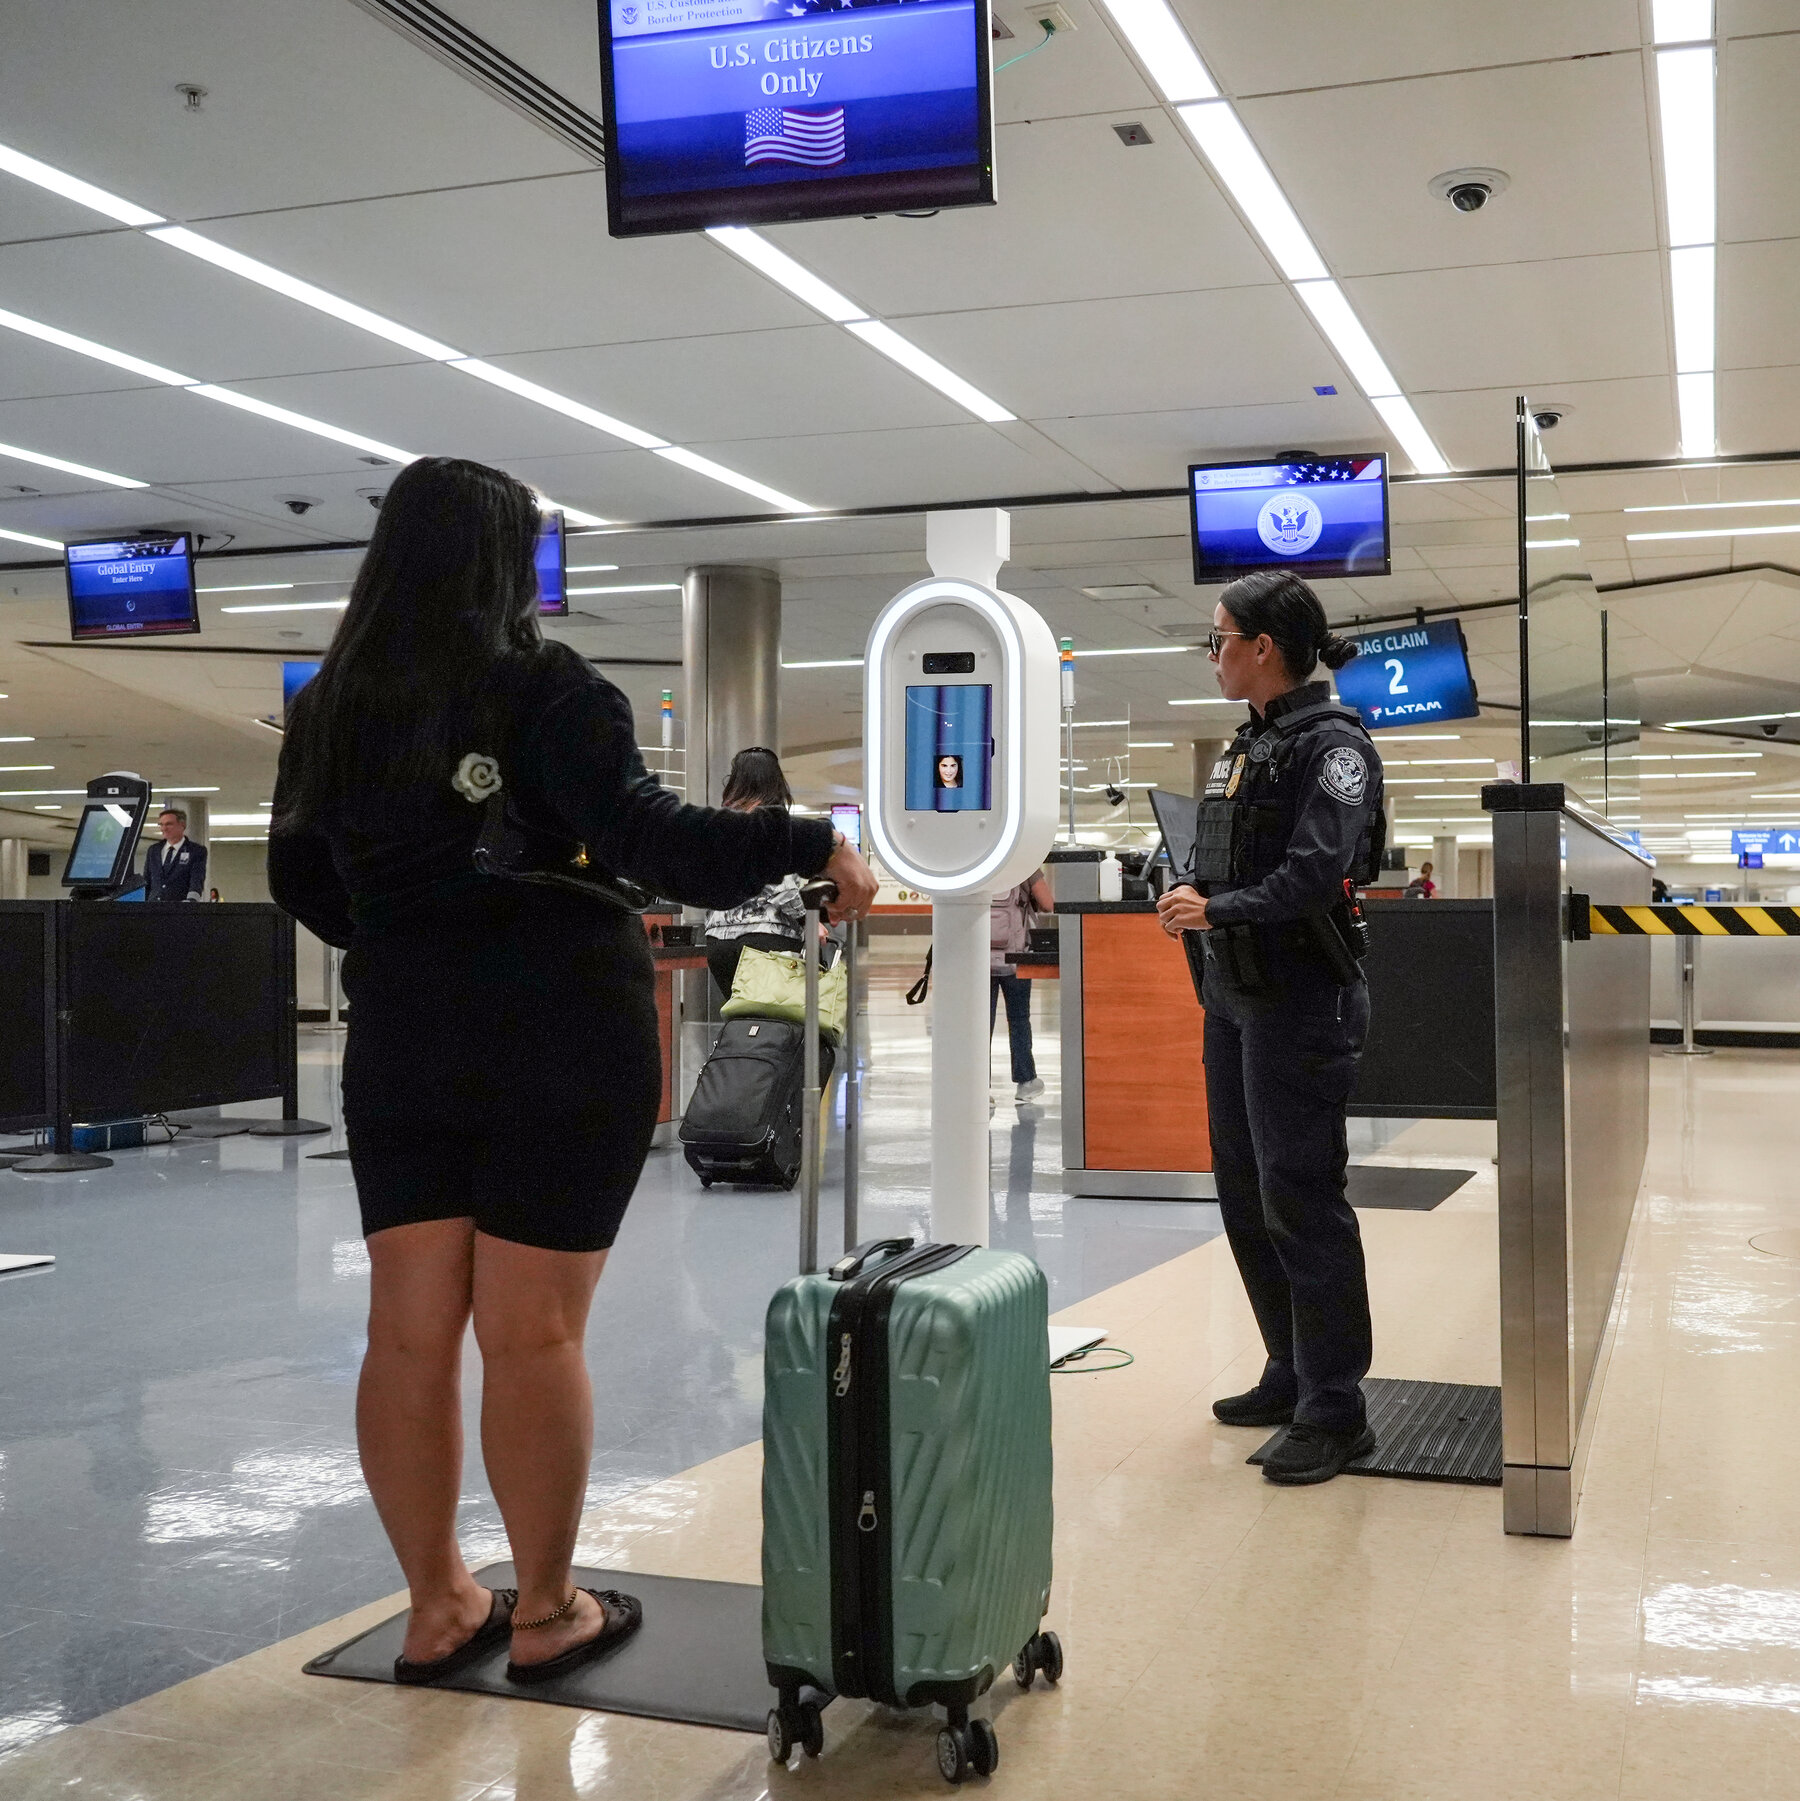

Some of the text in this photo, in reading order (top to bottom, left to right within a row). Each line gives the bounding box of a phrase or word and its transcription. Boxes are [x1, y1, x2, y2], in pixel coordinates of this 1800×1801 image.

[647, 0, 667, 11] U.S.
[647, 6, 743, 25] Border Protection
[709, 34, 873, 69] U.S. Citizens
[761, 68, 824, 98] Only
[97, 562, 156, 576] Global Entry
[129, 575, 143, 583] Here
[106, 622, 144, 631] GLOBAL ENTRY
[1355, 630, 1429, 656] BAG CLAIM
[1384, 658, 1409, 695] 2
[1385, 700, 1442, 716] LATAM
